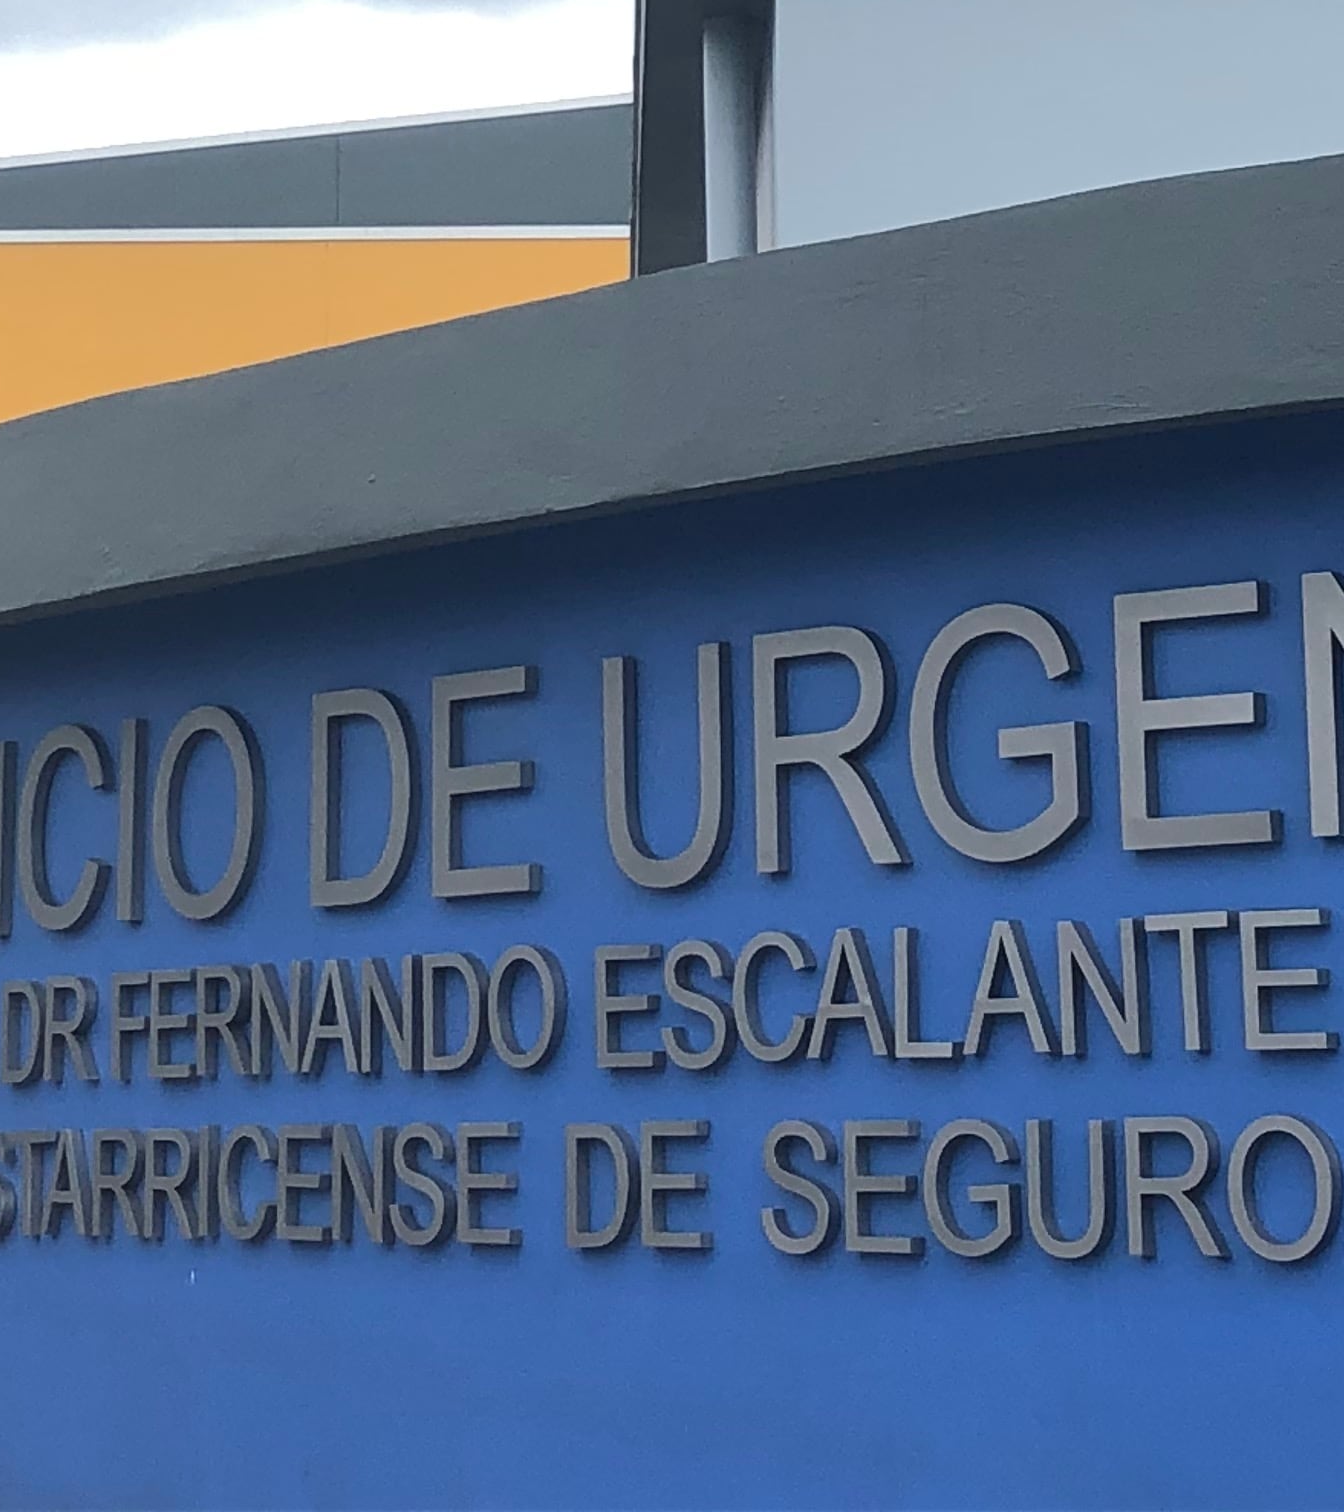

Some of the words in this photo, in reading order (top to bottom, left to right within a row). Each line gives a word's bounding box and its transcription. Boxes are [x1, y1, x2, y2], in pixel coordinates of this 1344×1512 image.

[310, 665, 539, 908] DE
[0, 975, 100, 1086] DR
[110, 944, 567, 1082] FERNANDO
[593, 908, 1337, 1070] ESCALANTE
[564, 1119, 712, 1251] DE
[761, 1114, 1341, 1263] SEGURO
